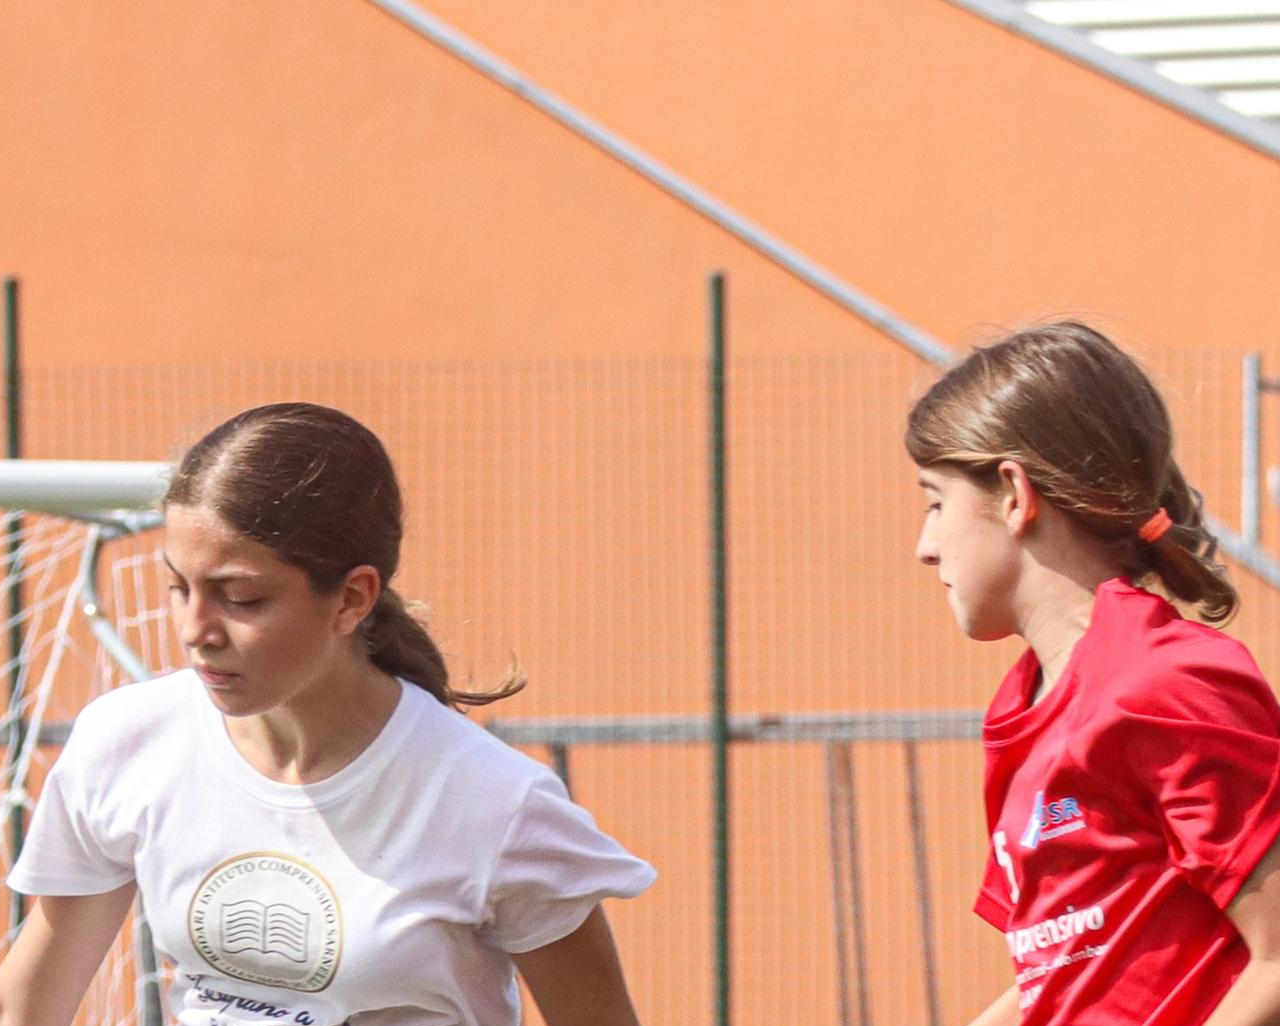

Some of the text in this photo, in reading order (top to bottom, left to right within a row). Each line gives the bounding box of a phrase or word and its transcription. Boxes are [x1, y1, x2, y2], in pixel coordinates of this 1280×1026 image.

[200, 862, 257, 905] ISTITUTO
[259, 860, 336, 925] COMPRENSIVO
[295, 1010, 315, 1026] a
